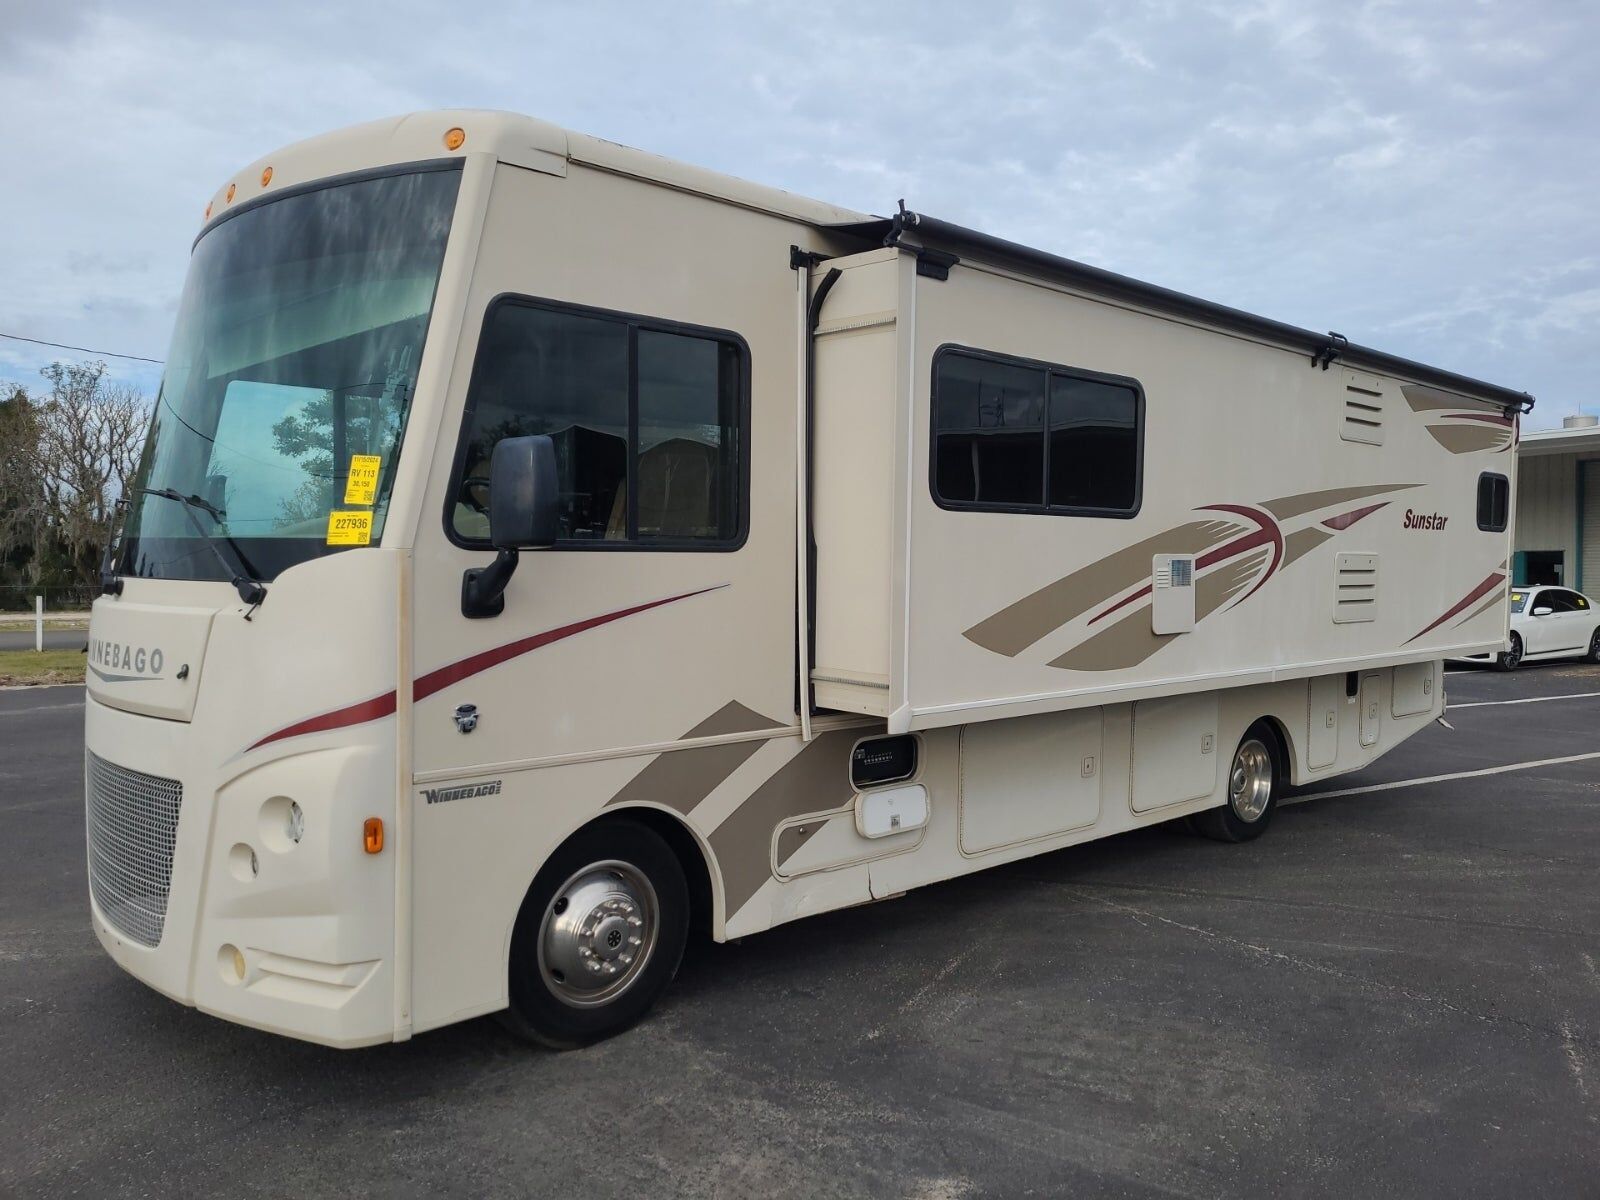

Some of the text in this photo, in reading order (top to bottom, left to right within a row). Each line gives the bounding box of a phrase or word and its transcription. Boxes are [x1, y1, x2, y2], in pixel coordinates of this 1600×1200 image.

[351, 468, 376, 478] RV 113
[335, 518, 368, 529] 227936
[1403, 508, 1449, 531] Sunstar
